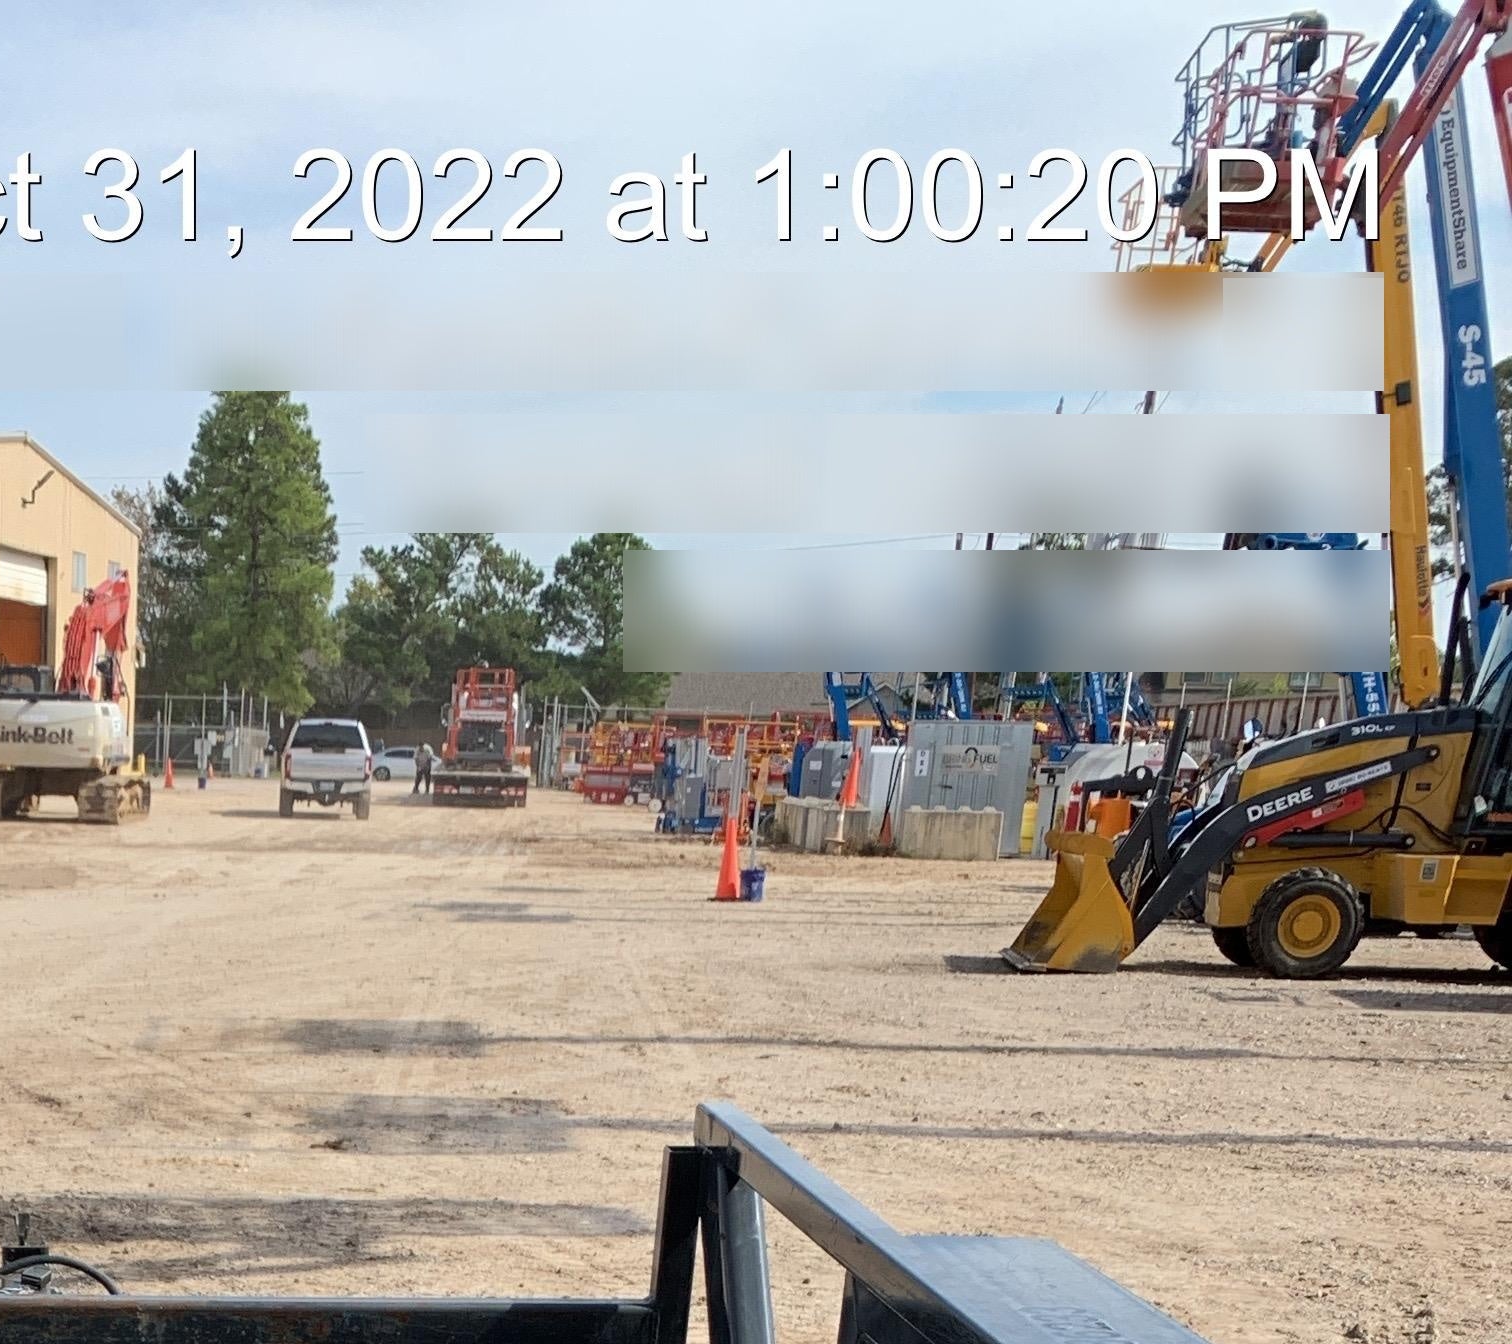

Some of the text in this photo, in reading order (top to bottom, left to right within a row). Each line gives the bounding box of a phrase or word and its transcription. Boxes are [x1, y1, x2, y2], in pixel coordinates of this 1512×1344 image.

[1440, 117, 1468, 271] EquipmentShare
[1458, 324, 1487, 386] S-45
[973, 753, 998, 764] FUEL
[1246, 786, 1314, 822] DEERE
